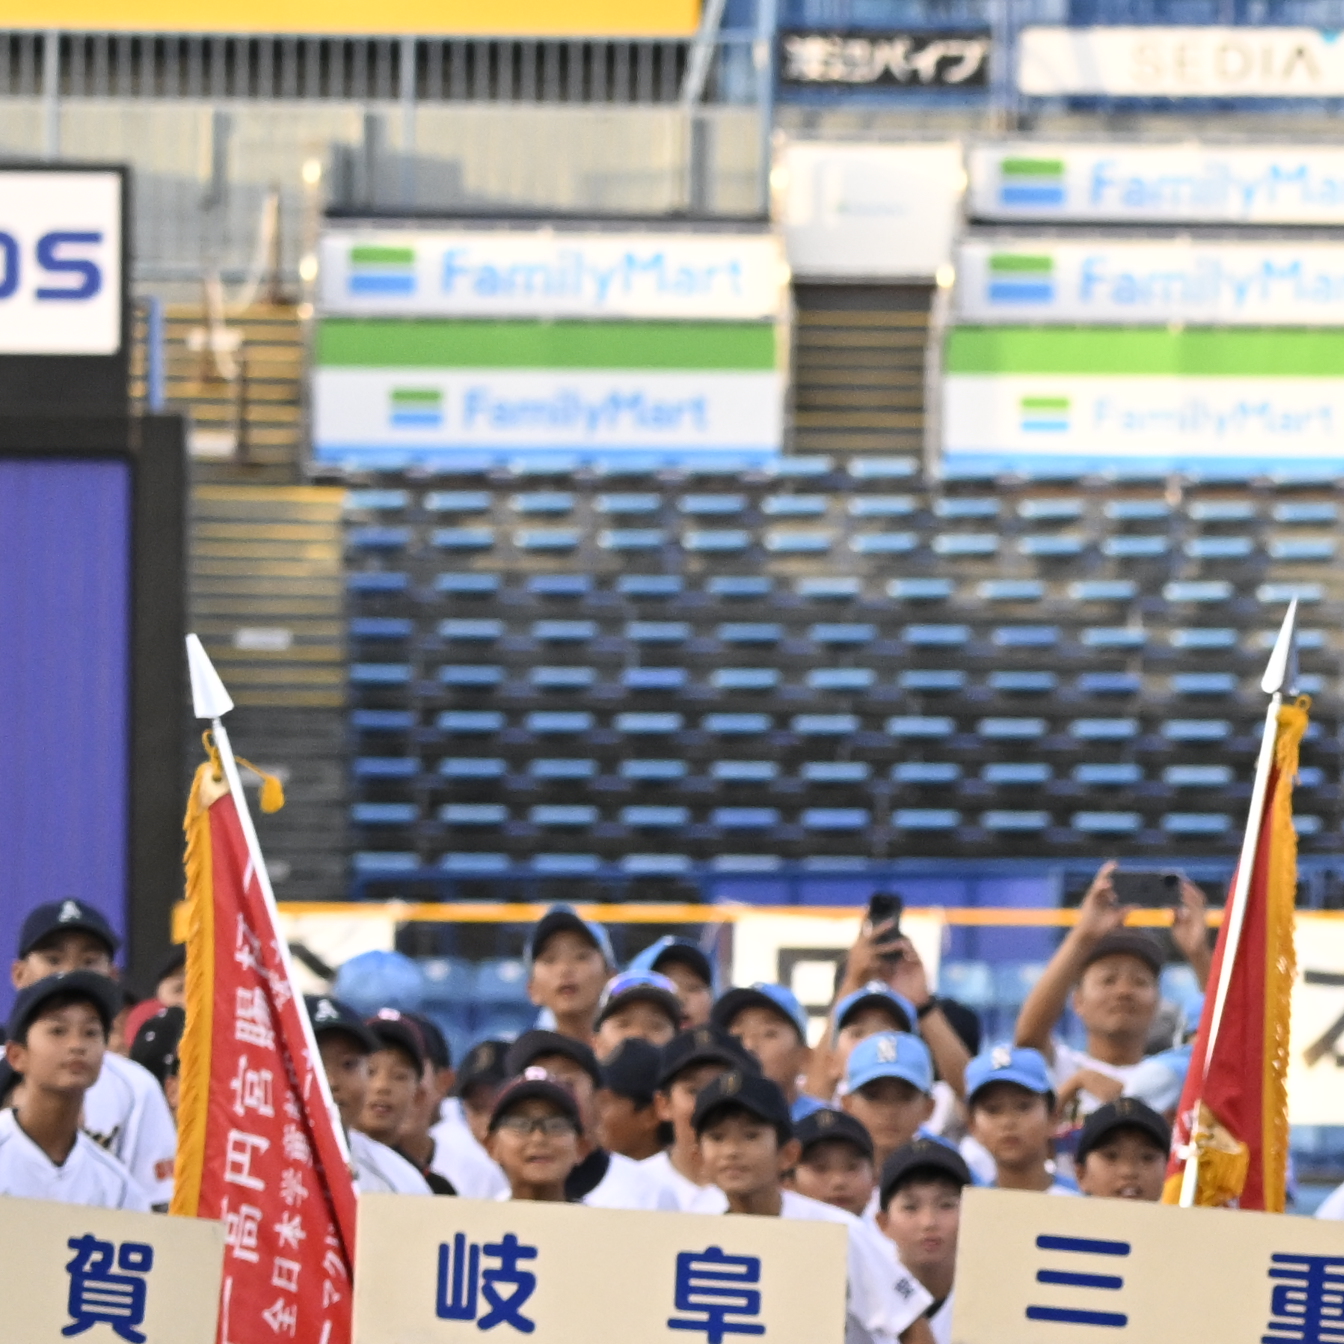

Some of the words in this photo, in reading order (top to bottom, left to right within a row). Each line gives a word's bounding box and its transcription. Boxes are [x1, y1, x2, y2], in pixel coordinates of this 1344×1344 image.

[1131, 43, 1325, 79] SEDIA
[440, 249, 744, 300] FamilyMart
[463, 388, 708, 433] FamilyMart
[1094, 400, 1335, 438] FamilyMart
[61, 1233, 154, 1344] 賀
